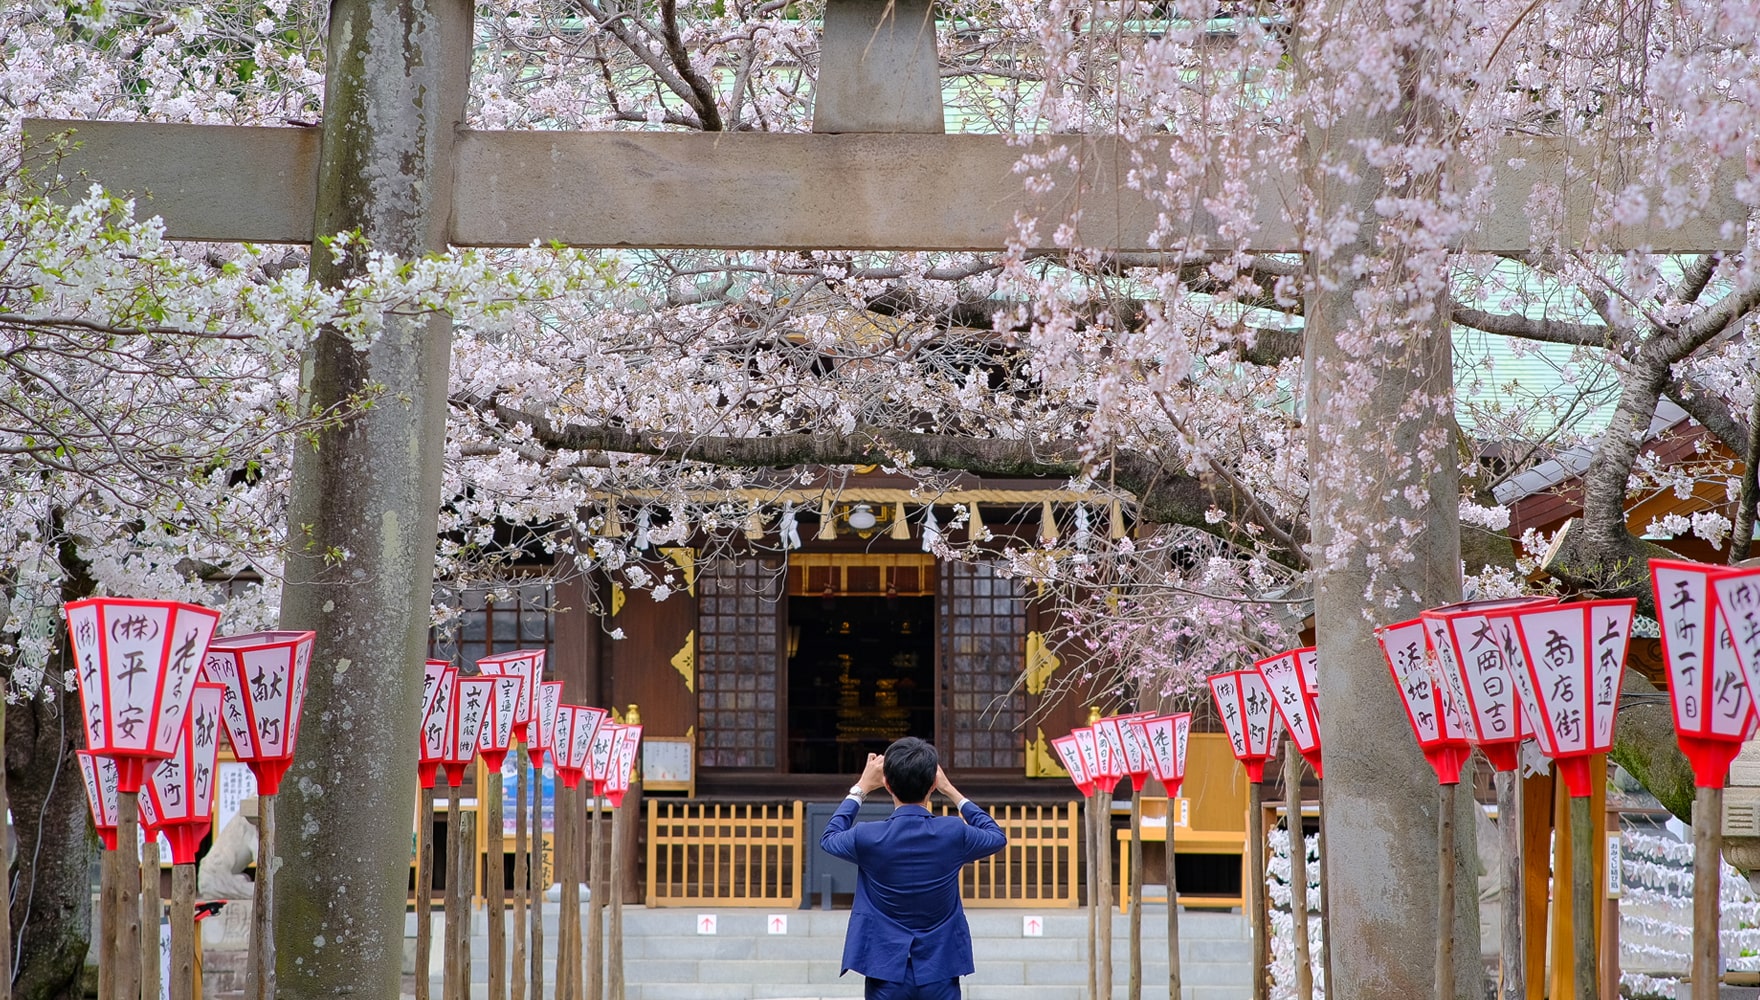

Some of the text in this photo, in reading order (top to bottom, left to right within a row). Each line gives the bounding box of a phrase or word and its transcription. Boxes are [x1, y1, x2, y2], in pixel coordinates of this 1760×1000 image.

[111, 613, 159, 740] (株)平安
[250, 665, 284, 745] 献灯
[1246, 686, 1269, 746] 献灯
[1541, 629, 1581, 743] 商店街
[1597, 616, 1620, 736] 上本通り
[594, 738, 610, 775] 献灯
[1154, 726, 1171, 775] 花まつり
